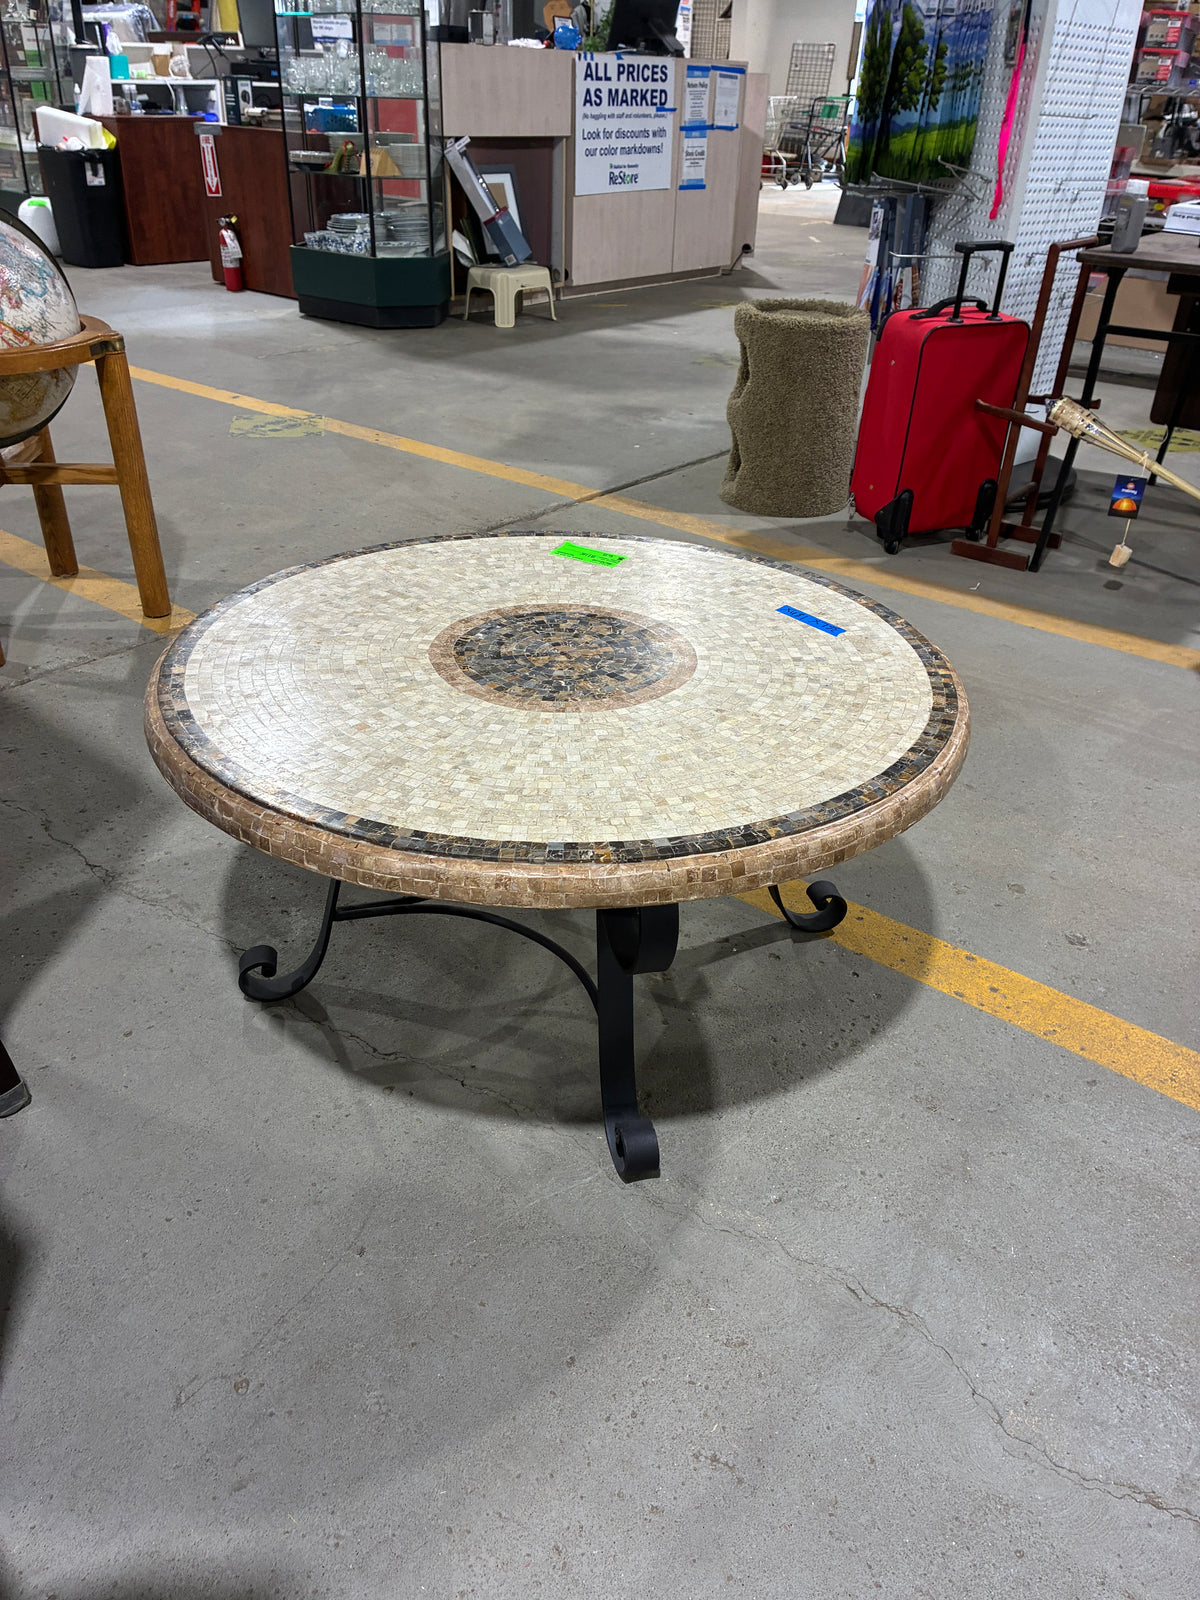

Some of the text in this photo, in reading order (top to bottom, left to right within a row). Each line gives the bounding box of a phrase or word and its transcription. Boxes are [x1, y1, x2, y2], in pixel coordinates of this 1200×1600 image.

[584, 62, 668, 83] ALL PRICES
[582, 87, 603, 107] AS
[607, 88, 668, 107] MARKED
[582, 126, 667, 140] Look for discounts with
[584, 142, 664, 157] our color markdowns!
[608, 170, 639, 185] ReStore
